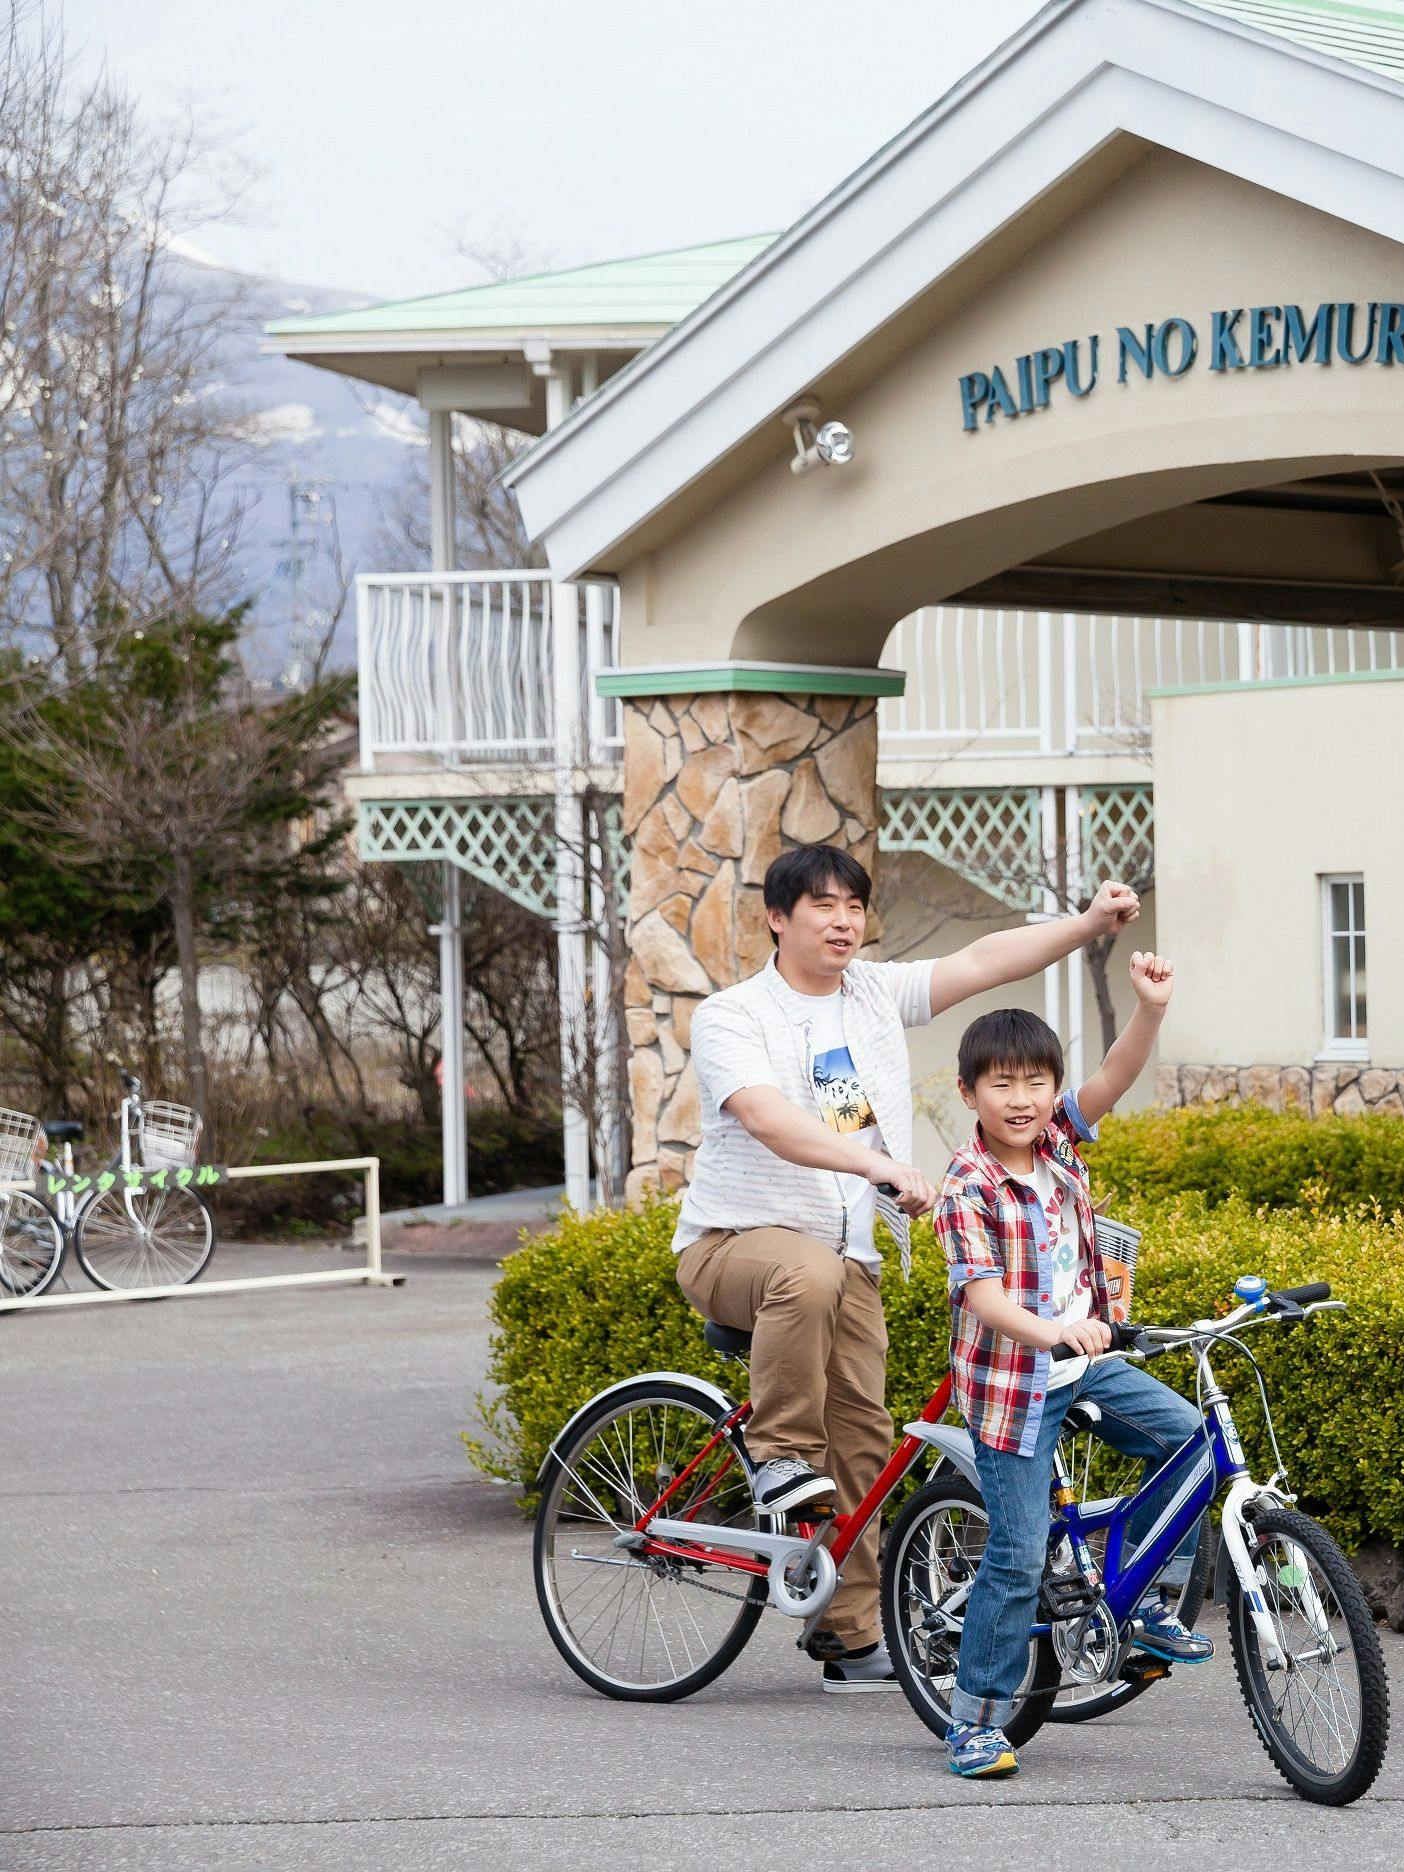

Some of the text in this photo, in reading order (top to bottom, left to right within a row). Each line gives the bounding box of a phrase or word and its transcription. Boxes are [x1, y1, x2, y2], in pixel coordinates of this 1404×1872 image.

[958, 335, 1099, 431] PAIPU
[1116, 317, 1198, 384] NO
[48, 1165, 220, 1195] レンタサイクル
